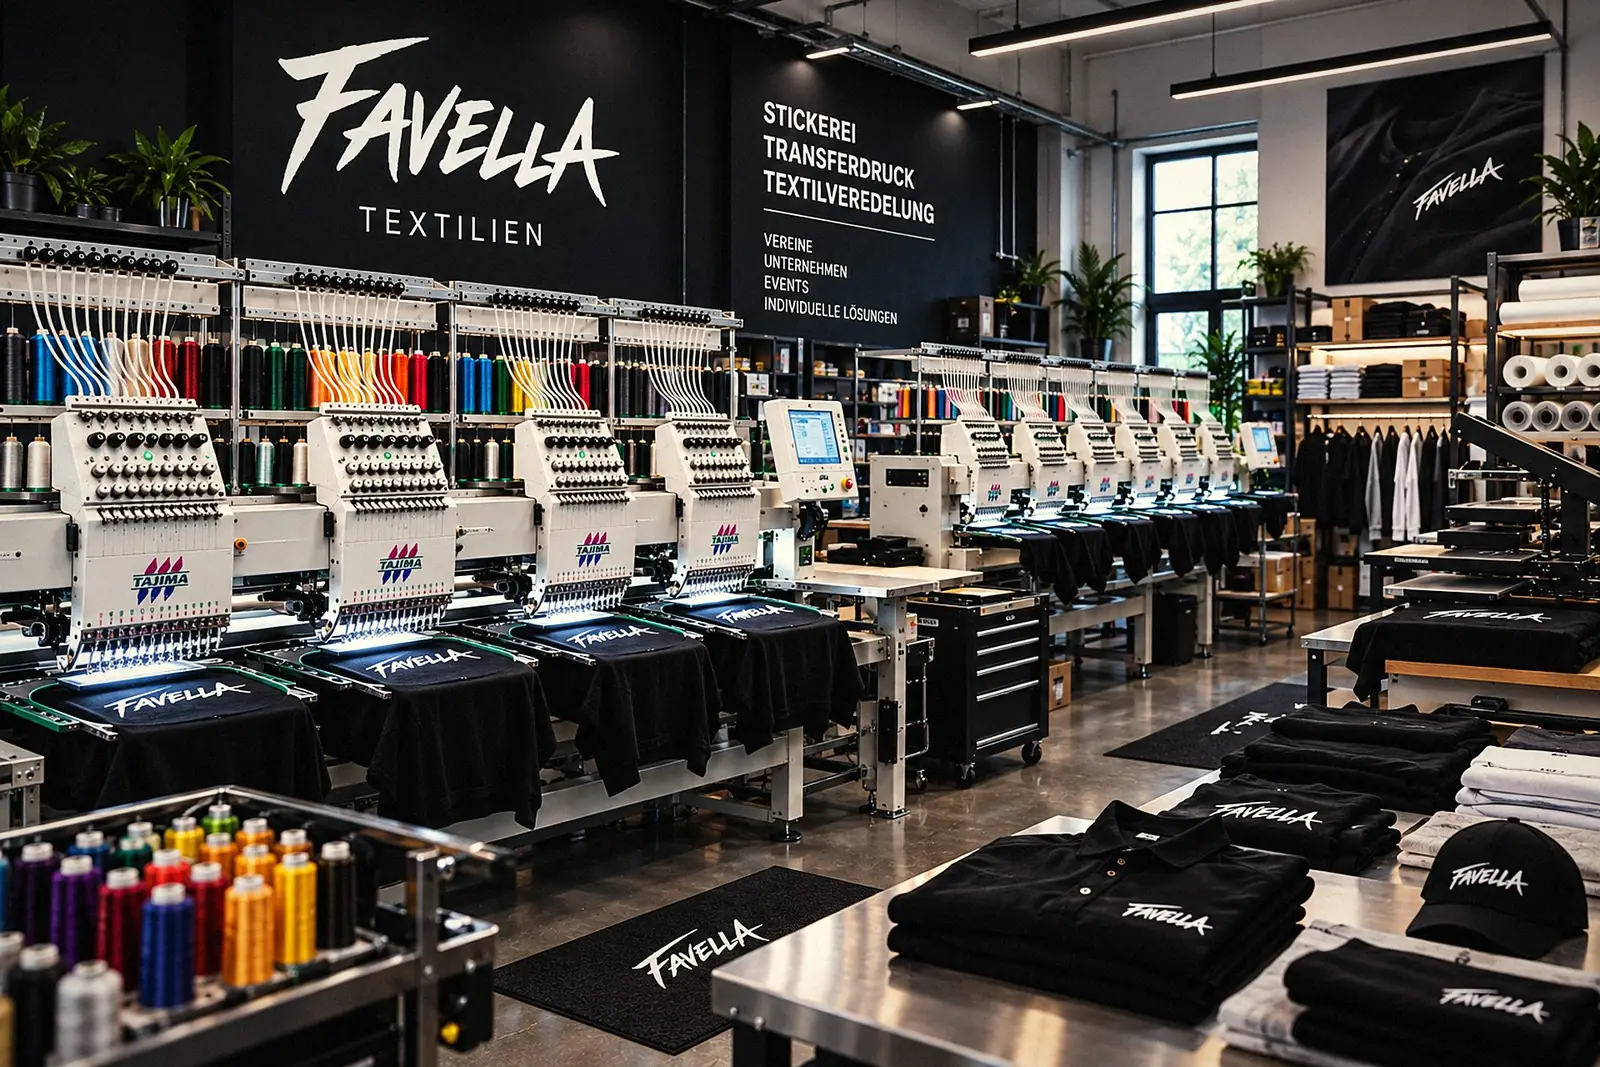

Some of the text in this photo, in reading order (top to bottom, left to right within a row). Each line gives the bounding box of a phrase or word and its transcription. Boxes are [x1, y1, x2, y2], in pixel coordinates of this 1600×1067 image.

[278, 37, 619, 207] FAVELLA
[764, 101, 855, 143] STICKEREI
[764, 134, 914, 190] TRANSFERDRUCK
[764, 169, 935, 225] TEXTILVEREDELUNG
[1413, 157, 1504, 220] FAVELLA
[359, 206, 542, 247] TEXTILIEN
[764, 232, 813, 254] VEREINE
[764, 254, 848, 279] UNTERNEHMEN
[764, 275, 809, 295] EVENTS
[764, 297, 898, 325] INDIVIDUELLE LÖSUNGEN
[133, 574, 189, 588] TAJIMA
[566, 625, 660, 648] FAVELLA
[366, 648, 481, 679] FAVELLA
[104, 682, 251, 718] FAVELLA
[1210, 801, 1322, 830] FAVELLA
[1449, 862, 1528, 896] FAVELLA
[1120, 902, 1213, 936] FAVELLA
[632, 918, 770, 989] FAVELLA
[1439, 988, 1549, 1024] FAVELLA
